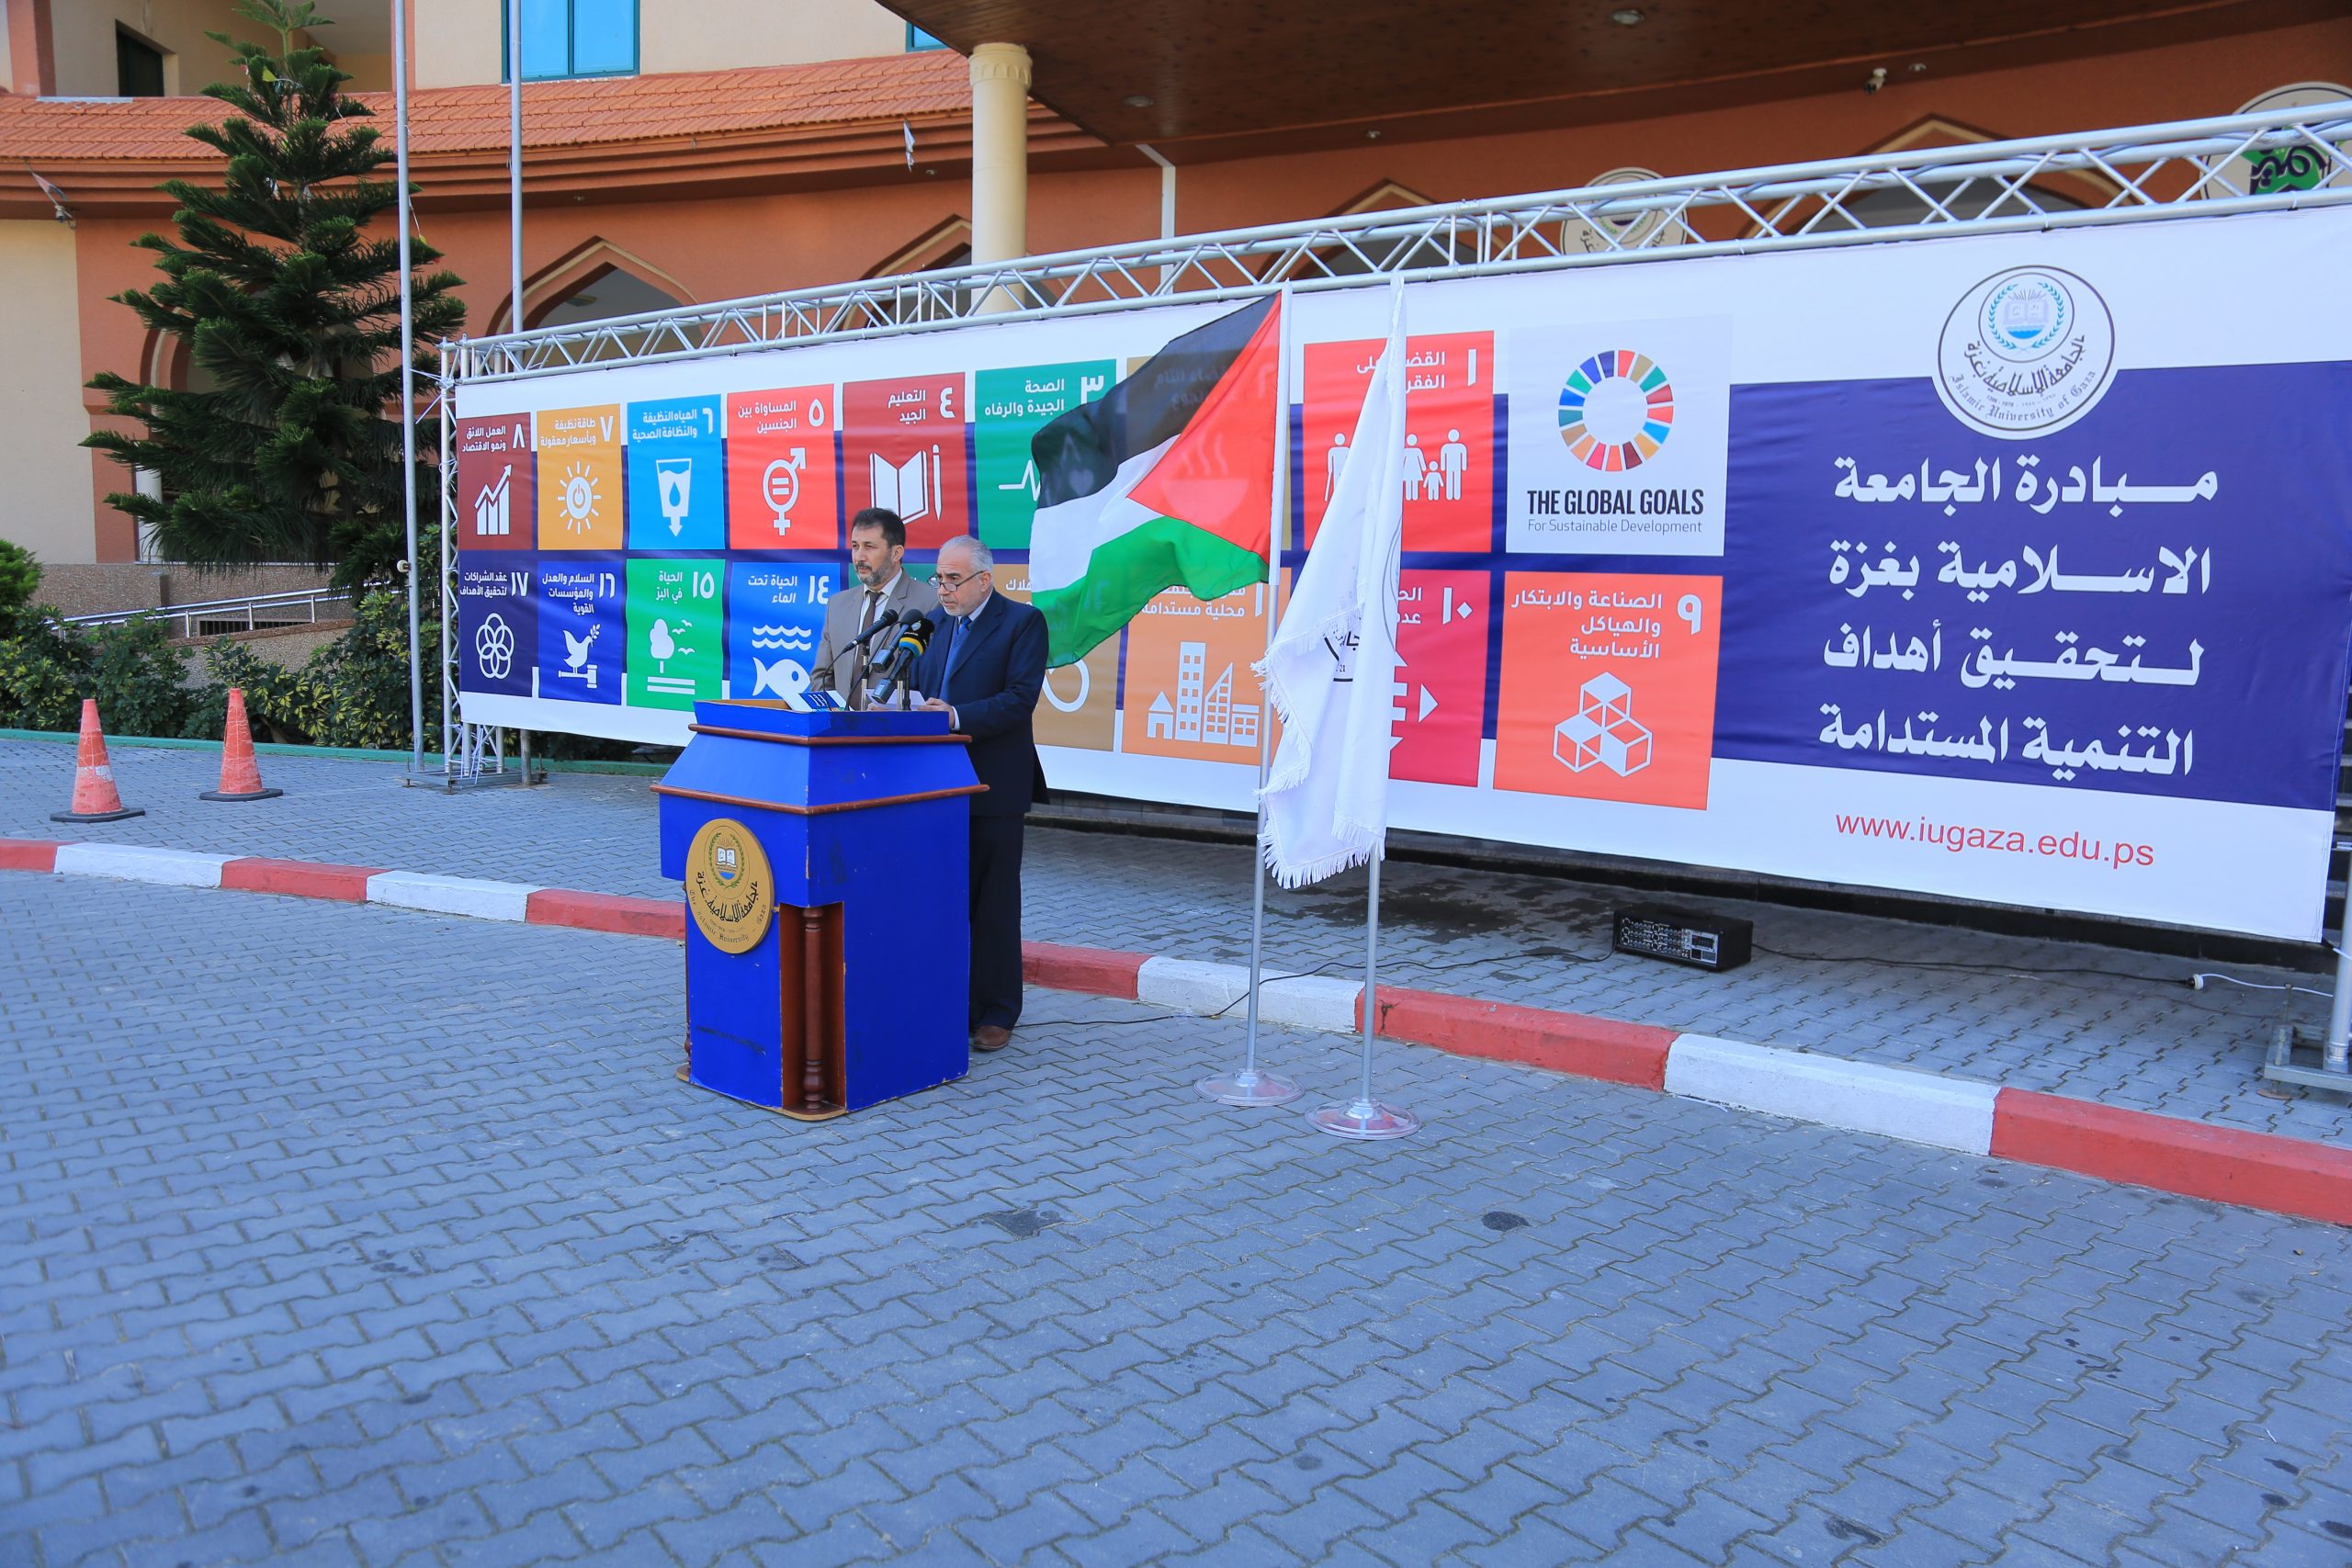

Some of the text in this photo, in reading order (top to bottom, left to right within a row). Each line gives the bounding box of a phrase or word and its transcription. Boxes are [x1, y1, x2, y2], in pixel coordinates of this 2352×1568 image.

[1024, 378, 1065, 393] الصحة
[2070, 362, 2096, 397] Gaza
[888, 389, 926, 409] التعليم
[940, 387, 956, 418] ٤
[643, 409, 697, 425] المياه النظيفة
[738, 400, 797, 418] المساواة بين
[808, 399, 824, 427] ٥
[899, 408, 926, 424] الجيد
[985, 399, 1065, 418] الجيدة والرفاه
[555, 417, 596, 433] طاقة نظيفة
[600, 415, 614, 442] ٧
[702, 407, 713, 434] ٦
[757, 418, 797, 434] الجنسين
[486, 425, 506, 438] العمل
[513, 423, 526, 448] ٨
[540, 431, 596, 448] وبأسعار معقولة
[632, 425, 697, 443] والنظافة الصحية
[462, 440, 506, 452] ونمو الاقتصاد
[1834, 456, 2000, 517] الجامعة
[1527, 489, 1704, 515] THE GLOBAL GOALS
[1528, 519, 1702, 536] For Sustainable Development
[464, 570, 507, 583] عقد الشراكات
[542, 573, 594, 586] السلام والعدل
[659, 570, 683, 584] الحياة
[1829, 539, 1920, 602] بغزة
[693, 571, 715, 599] ١٥
[748, 574, 797, 589] الحياة تحت
[459, 585, 507, 598] لتحقيق الأهداف
[548, 587, 594, 601] والمؤسسات
[672, 588, 683, 604] في
[772, 592, 796, 604] الماء
[1511, 589, 1662, 610] الصناعة والابتكار
[573, 603, 594, 615] القوية
[1205, 602, 1245, 620] محلية
[1677, 593, 1702, 636] ٩
[1580, 616, 1661, 637] والهياكل
[1569, 638, 1660, 660] الأساسية
[1824, 619, 1941, 673] أهداف
[1818, 703, 2194, 782] التنمية المستدامة
[1836, 813, 2154, 870] www.iugaza.edu.ps
